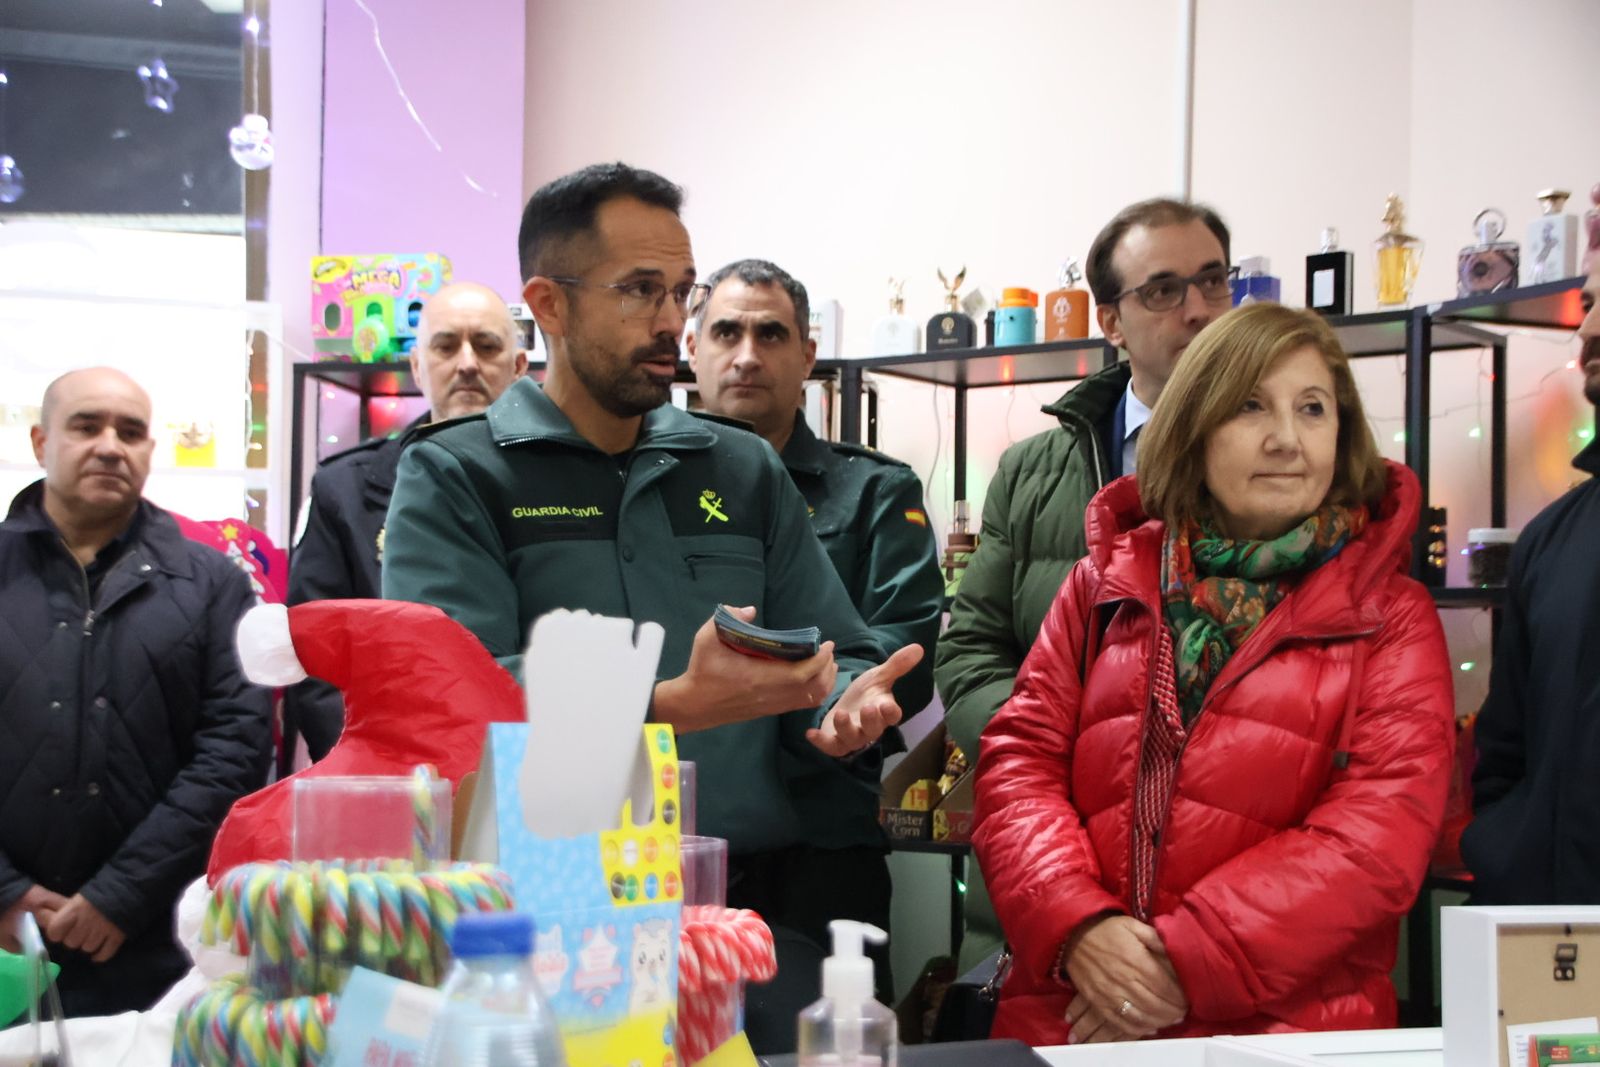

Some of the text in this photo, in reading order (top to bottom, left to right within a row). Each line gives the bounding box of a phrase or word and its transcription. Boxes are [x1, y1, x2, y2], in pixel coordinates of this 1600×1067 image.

[512, 506, 603, 518] GUARDIA CIVIL
[887, 811, 923, 826] Mister
[891, 824, 921, 837] Corn
